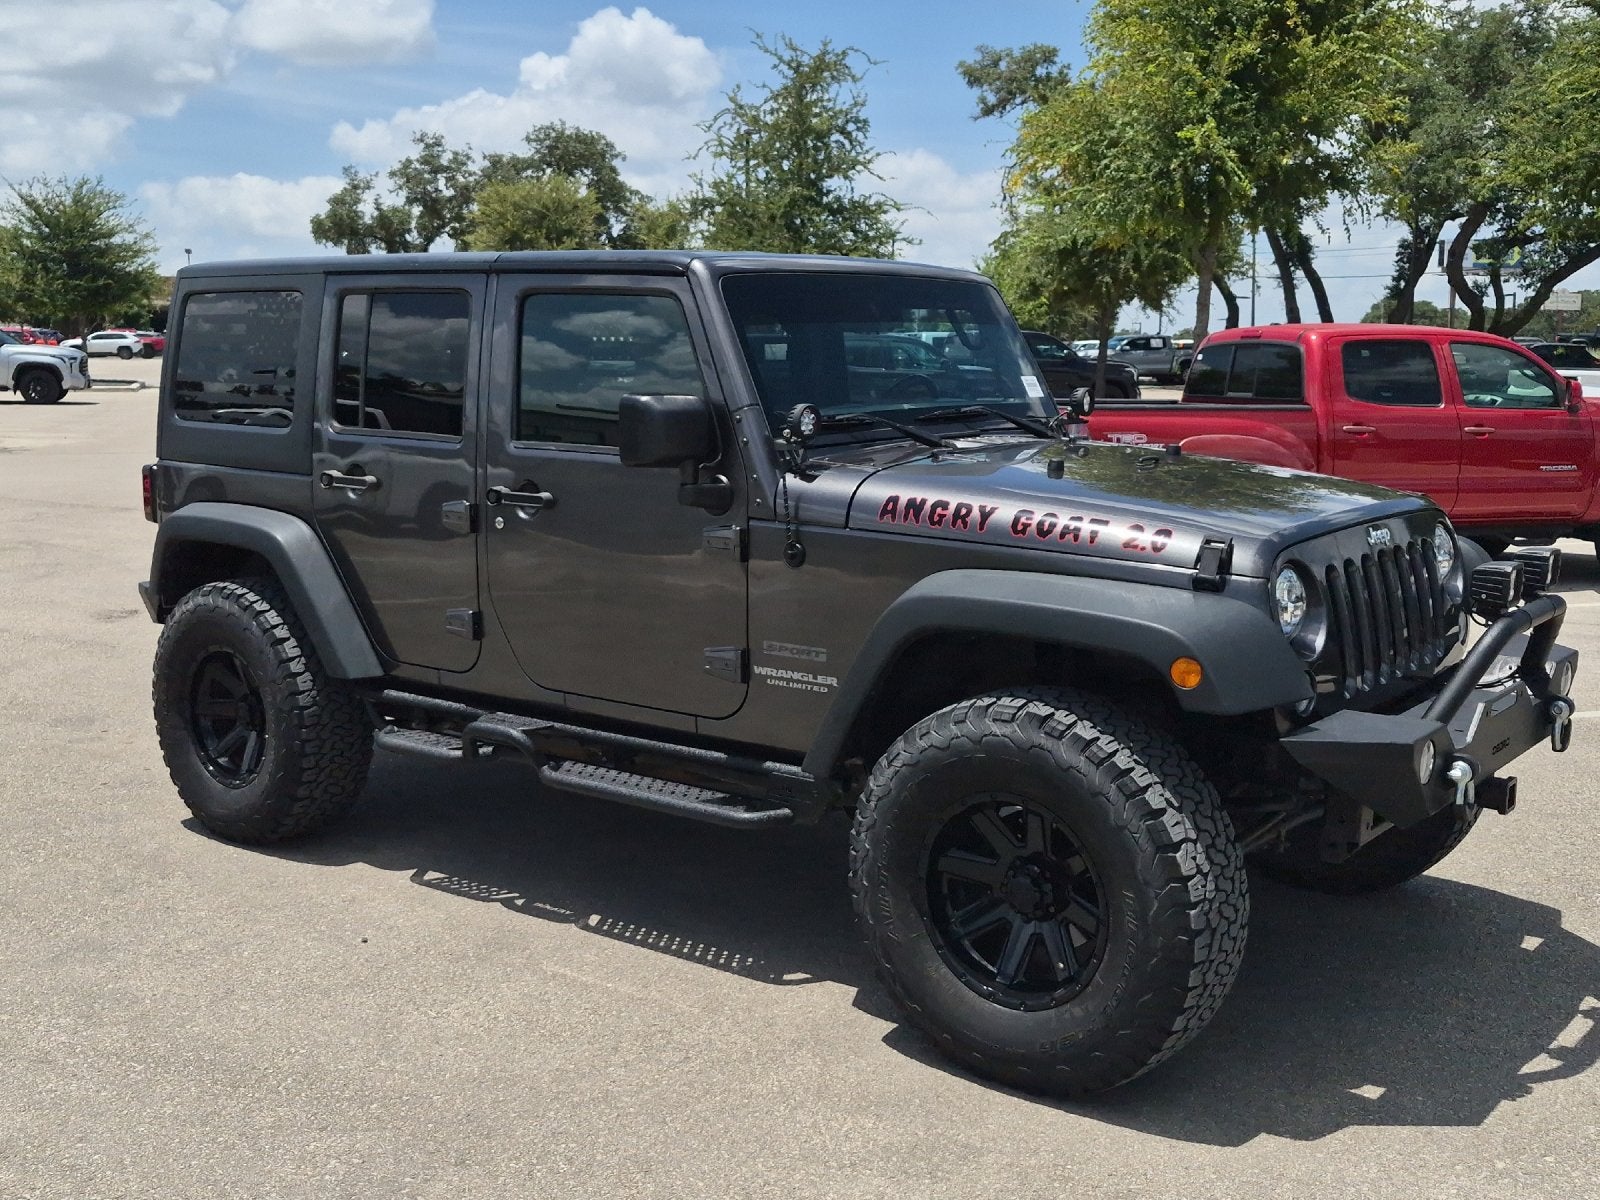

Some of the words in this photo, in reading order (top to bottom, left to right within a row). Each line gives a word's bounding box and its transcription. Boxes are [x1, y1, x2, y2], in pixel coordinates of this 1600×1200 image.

[1539, 464, 1578, 472] TACOMA
[877, 494, 999, 533] ANGRY
[1009, 508, 1111, 545] GOAT
[1121, 522, 1174, 554] 2.0
[1367, 526, 1391, 546] Jeep
[765, 642, 826, 660] SPORT
[753, 665, 839, 687] WRANGLER
[766, 678, 829, 693] UNLIMITED
